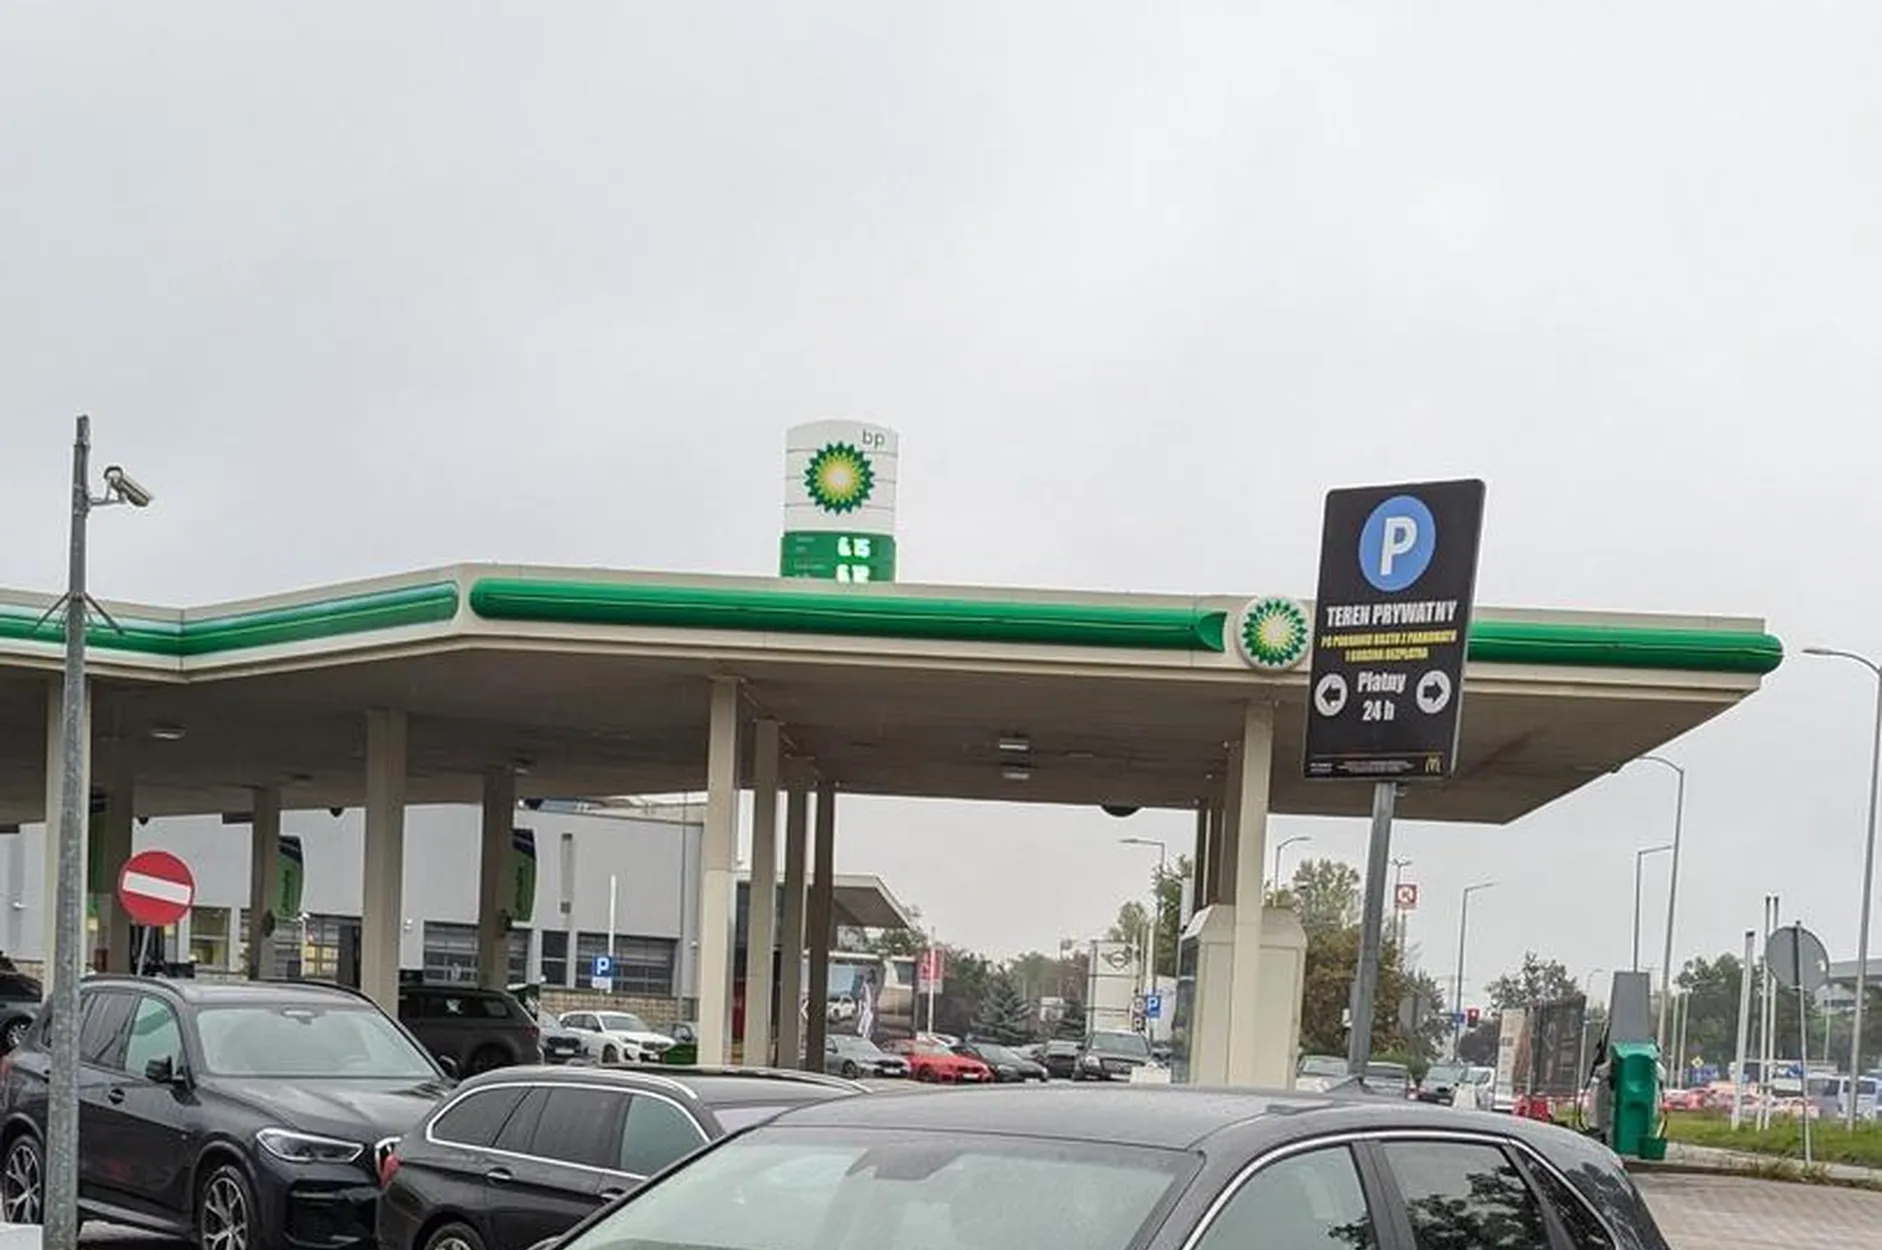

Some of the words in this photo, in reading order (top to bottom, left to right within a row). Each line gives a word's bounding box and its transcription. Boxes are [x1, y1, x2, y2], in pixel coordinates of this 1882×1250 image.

[862, 429, 885, 448] bp
[1380, 516, 1417, 576] P
[1326, 606, 1371, 628] TEREN
[1372, 600, 1458, 626] PRYWATNY
[1362, 700, 1382, 721] 24
[1383, 700, 1395, 721] h
[596, 957, 610, 975] P
